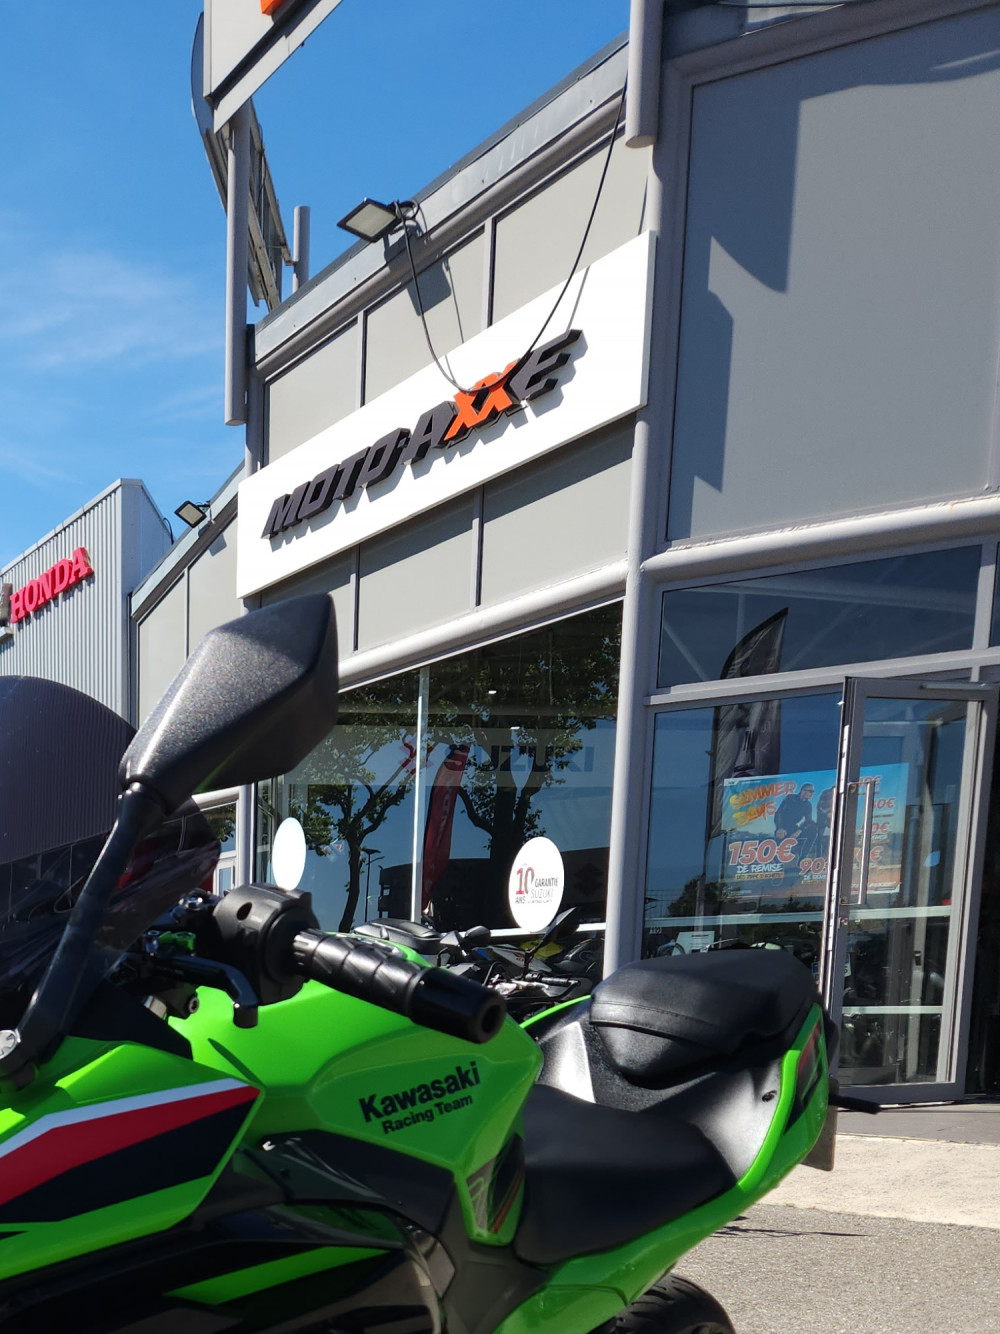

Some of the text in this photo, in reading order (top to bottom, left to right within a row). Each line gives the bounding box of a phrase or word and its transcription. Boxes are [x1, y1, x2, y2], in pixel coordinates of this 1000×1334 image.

[9, 546, 93, 624] HONDA
[729, 781, 797, 809] SUMMER
[729, 838, 798, 866] 150€
[799, 857, 828, 875] 90
[516, 867, 535, 895] 10
[535, 877, 559, 888] GARANTIE
[737, 863, 783, 874] DE REMISE
[531, 888, 554, 899] SUZUKI
[358, 1061, 480, 1123] Kawasaki
[382, 1095, 473, 1135] Racing Team
